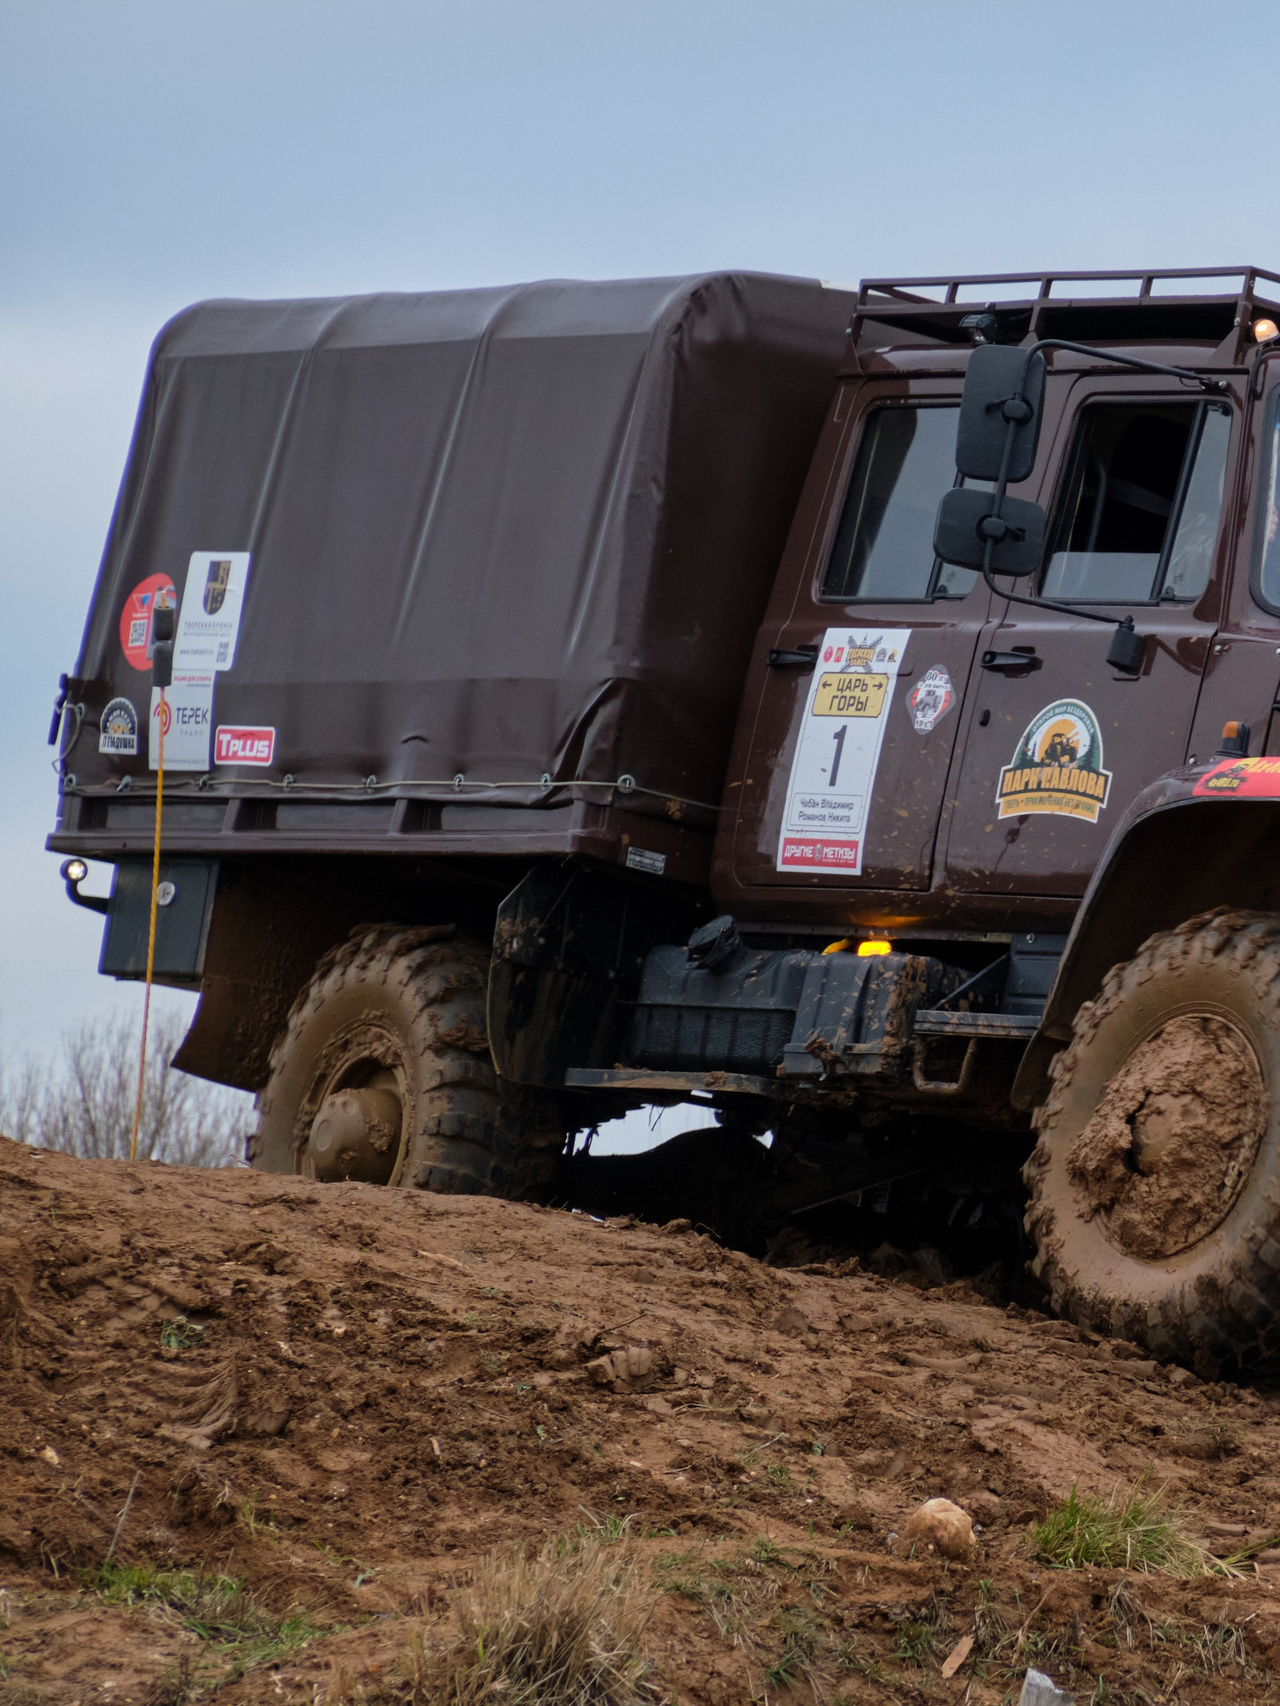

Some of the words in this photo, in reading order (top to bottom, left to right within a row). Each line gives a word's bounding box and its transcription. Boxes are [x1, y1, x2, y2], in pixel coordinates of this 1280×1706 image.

[836, 678, 869, 693] ЦАРЬ
[829, 696, 869, 711] ГОРЫ
[176, 707, 209, 725] ТЕРЕК
[1032, 709, 1054, 732] ОТКРОЙ
[828, 724, 847, 787] 1
[1002, 767, 1041, 794] ПАРК
[1041, 766, 1106, 799] ПАВЛОВА
[821, 799, 854, 812] Владимир
[798, 811, 826, 821] Романов
[827, 812, 851, 822] Никита
[784, 845, 814, 858] ДРУГИЕ
[822, 847, 856, 859] МЕТИЗЫ
